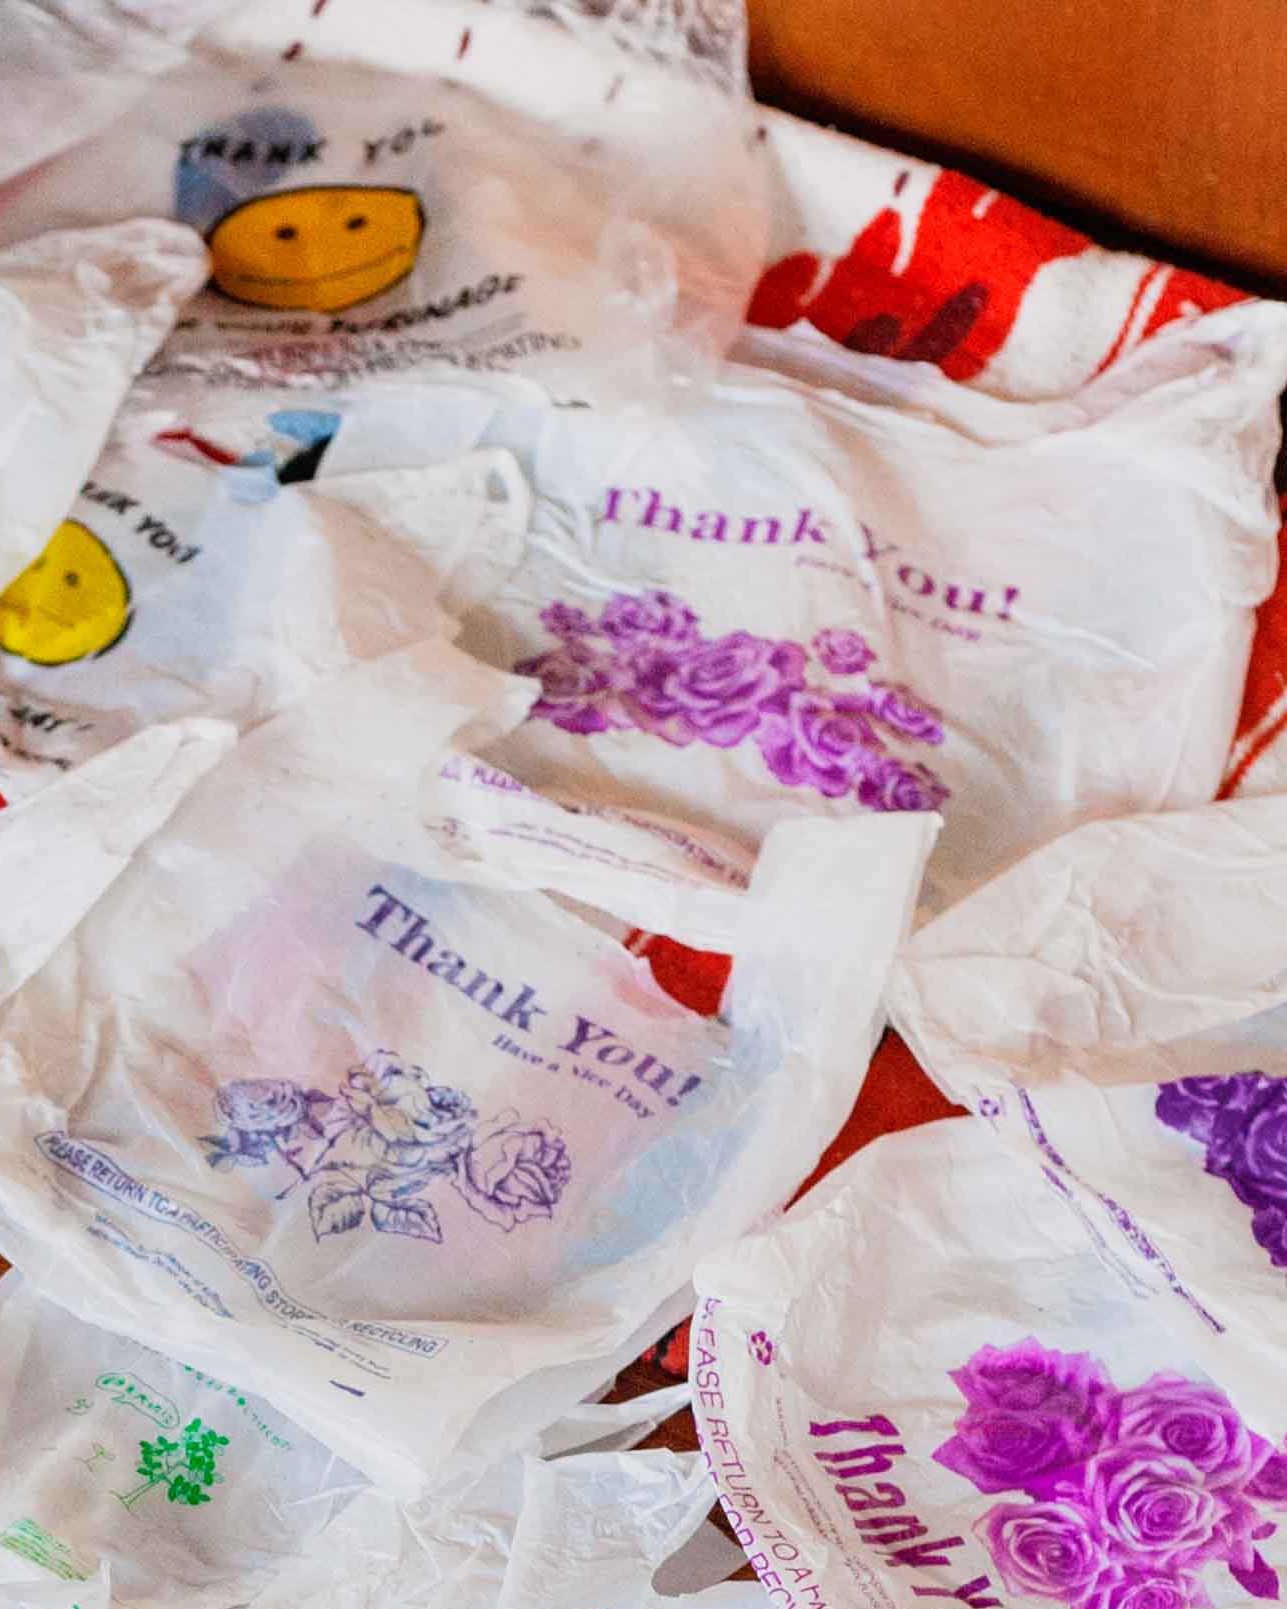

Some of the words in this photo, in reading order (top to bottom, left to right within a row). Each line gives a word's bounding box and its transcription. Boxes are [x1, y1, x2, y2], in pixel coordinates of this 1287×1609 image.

[602, 487, 831, 545] Thank
[858, 522, 1020, 622] You!
[353, 884, 546, 1036] Thank
[557, 1014, 702, 1109] You!
[490, 1032, 545, 1067] Have
[546, 1061, 561, 1073] a
[613, 1085, 657, 1121] Day
[87, 1159, 149, 1204] RETURN
[809, 1413, 965, 1568] Thank
[763, 1529, 800, 1562] TO
[785, 1566, 813, 1584] A
